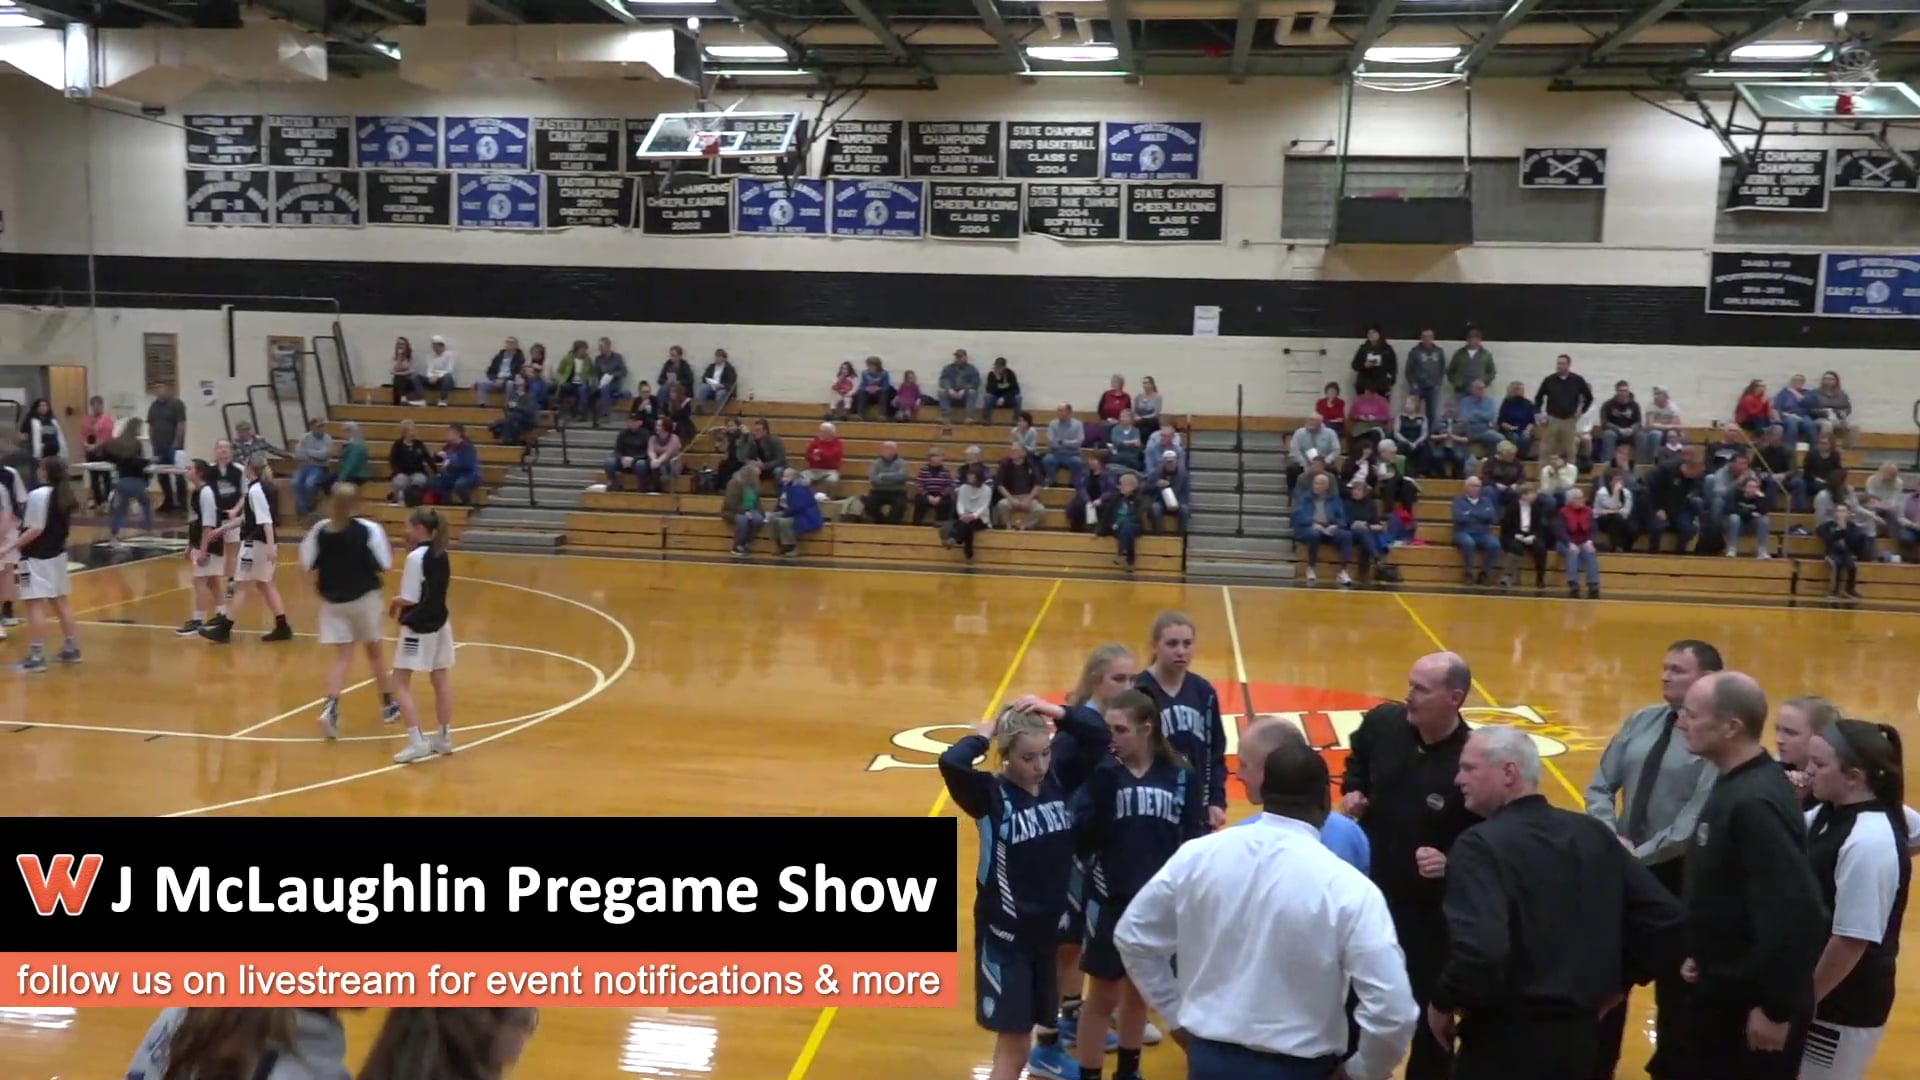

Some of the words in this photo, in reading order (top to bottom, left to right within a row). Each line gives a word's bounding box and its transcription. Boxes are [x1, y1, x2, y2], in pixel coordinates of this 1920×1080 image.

[734, 121, 755, 131] BIG
[757, 122, 791, 132] EAST
[834, 122, 863, 133] STERN
[1012, 126, 1042, 136] STATE
[1044, 126, 1095, 137] CHAMPIONS
[922, 134, 986, 145] CHAMPIONS
[1009, 139, 1034, 150] BOYS
[1036, 139, 1097, 150] BASKETBALL
[842, 145, 873, 154] 2003
[938, 145, 970, 154] 2004
[1027, 152, 1066, 162] CLASS
[1069, 152, 1079, 162] C
[1111, 152, 1133, 161] EAST
[1765, 151, 1822, 162] CHAMPIONS
[833, 164, 870, 173] CLASS
[872, 164, 881, 173] C
[930, 164, 967, 174] CLASS
[970, 164, 979, 174] C
[1035, 165, 1068, 174] 2004
[1757, 163, 1815, 174] CHAMPIONS
[560, 188, 619, 199] CHAMPIONS
[935, 186, 964, 197] STATE
[966, 187, 1016, 198] CHAMPIONS
[1030, 186, 1059, 196] STATE
[1060, 186, 1119, 197] RUNNERS-UP
[1133, 188, 1164, 199] STATE
[1166, 188, 1216, 199] CHAMPIONS
[1738, 186, 1769, 195] CLASS
[647, 196, 727, 208] CHEERLEADING
[932, 200, 1018, 211] CHEERLEADING
[742, 206, 764, 215] EAST
[1057, 208, 1089, 217] 2004
[1132, 202, 1216, 213] CHEERLEADING
[661, 210, 698, 219] CLASS
[837, 209, 858, 218] EAST
[950, 213, 988, 222] CLASS
[991, 213, 1001, 222] C
[1043, 217, 1104, 227] SOFTBALL
[1148, 215, 1188, 225] CLASS
[1190, 215, 1200, 225] C
[959, 225, 990, 234] 2004
[1049, 227, 1088, 236] CLASS
[1089, 227, 1099, 237] C
[1860, 268, 1899, 278] AWARD
[1826, 286, 1855, 296] EAST
[1749, 298, 1801, 306] BASKETBALL
[1173, 705, 1205, 742] DEVILS
[1012, 806, 1043, 845] LADY
